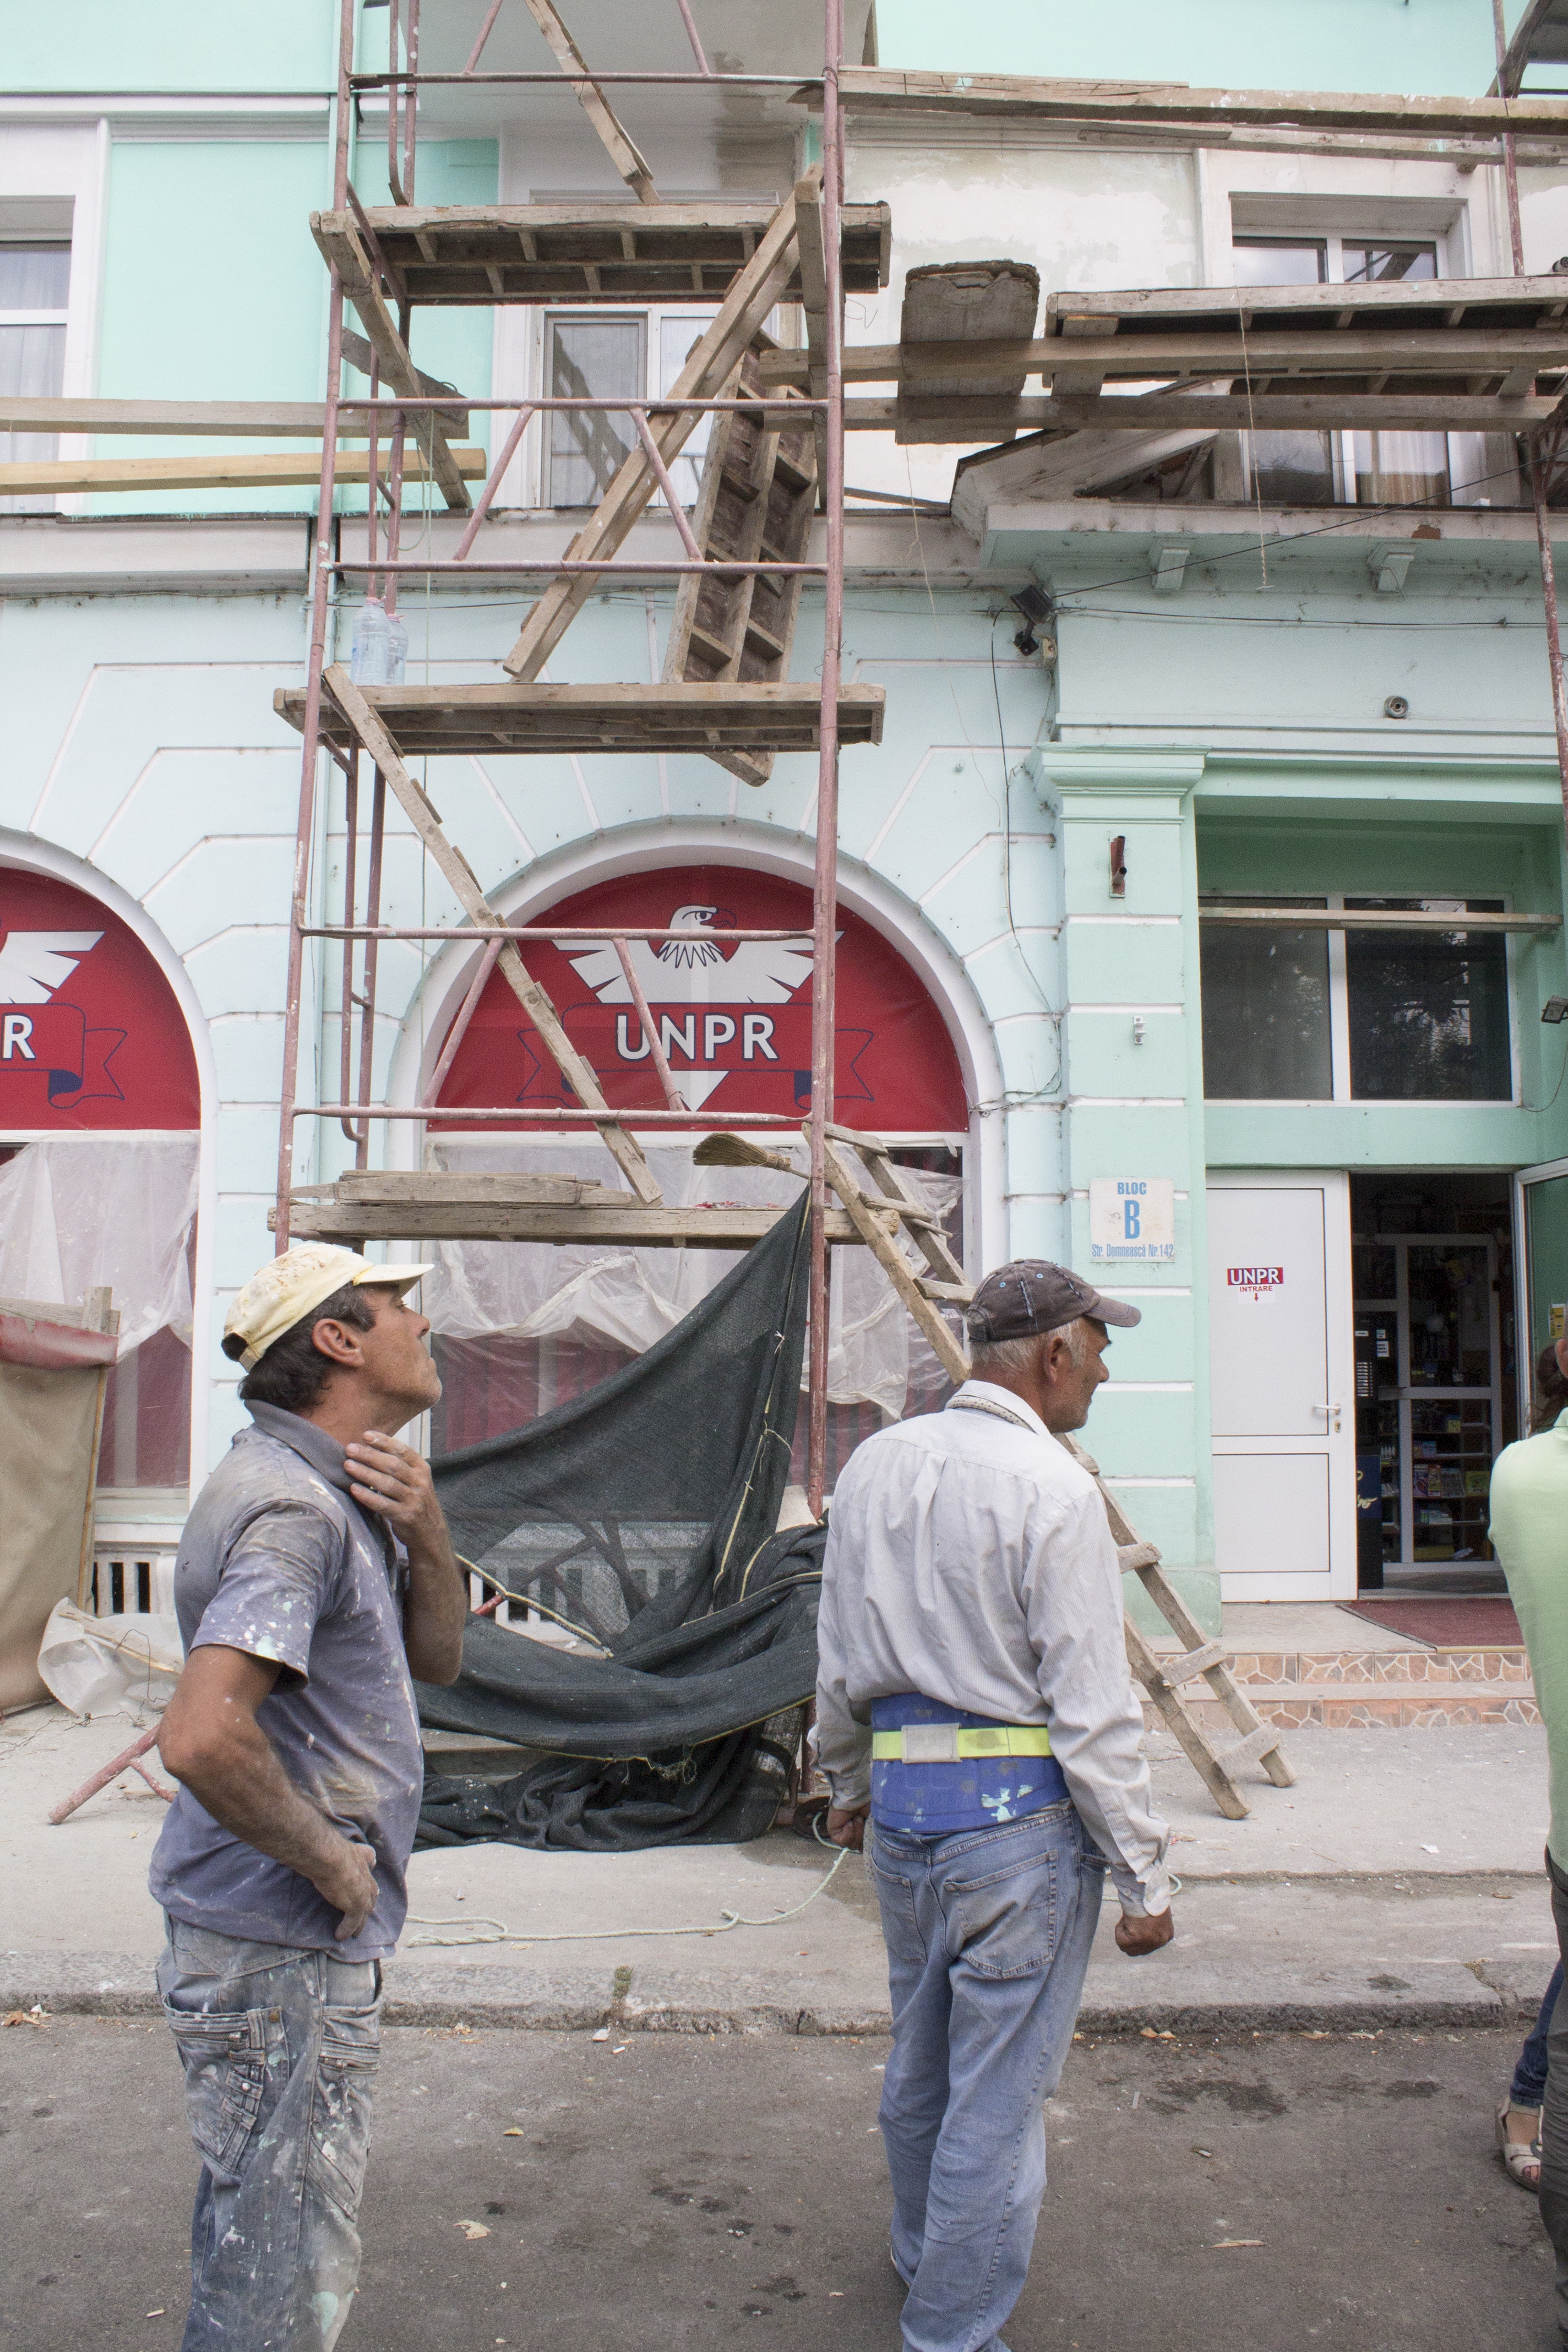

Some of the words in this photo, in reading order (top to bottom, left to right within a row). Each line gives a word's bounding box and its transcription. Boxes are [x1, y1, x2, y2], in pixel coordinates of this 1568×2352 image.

[617, 1014, 779, 1060] UNPR
[1117, 1182, 1147, 1195] BLOC
[1124, 1199, 1141, 1239] B
[1091, 1243, 1104, 1257] Str.
[1230, 1268, 1281, 1284] UNPR
